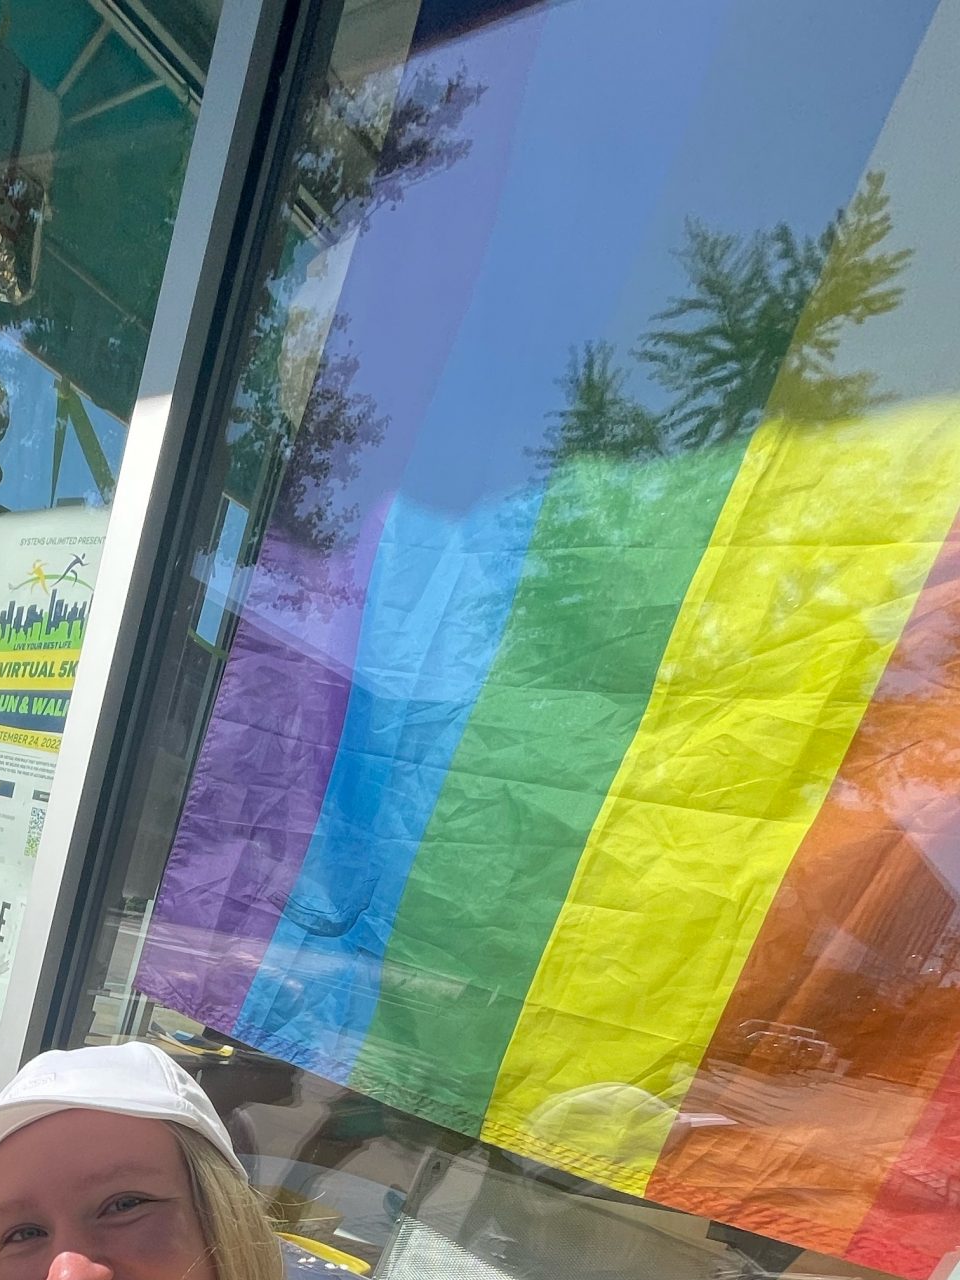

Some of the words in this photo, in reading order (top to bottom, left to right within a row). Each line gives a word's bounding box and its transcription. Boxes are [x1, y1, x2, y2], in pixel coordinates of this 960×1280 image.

[20, 537, 46, 546] SYSTEMS
[46, 537, 77, 546] UNLIMITED
[13, 643, 26, 651] LIVE
[26, 642, 43, 650] YOUR
[43, 642, 59, 650] BEST
[59, 641, 72, 649] LIFE
[58, 660, 79, 678] 5K
[19, 696, 29, 714] &
